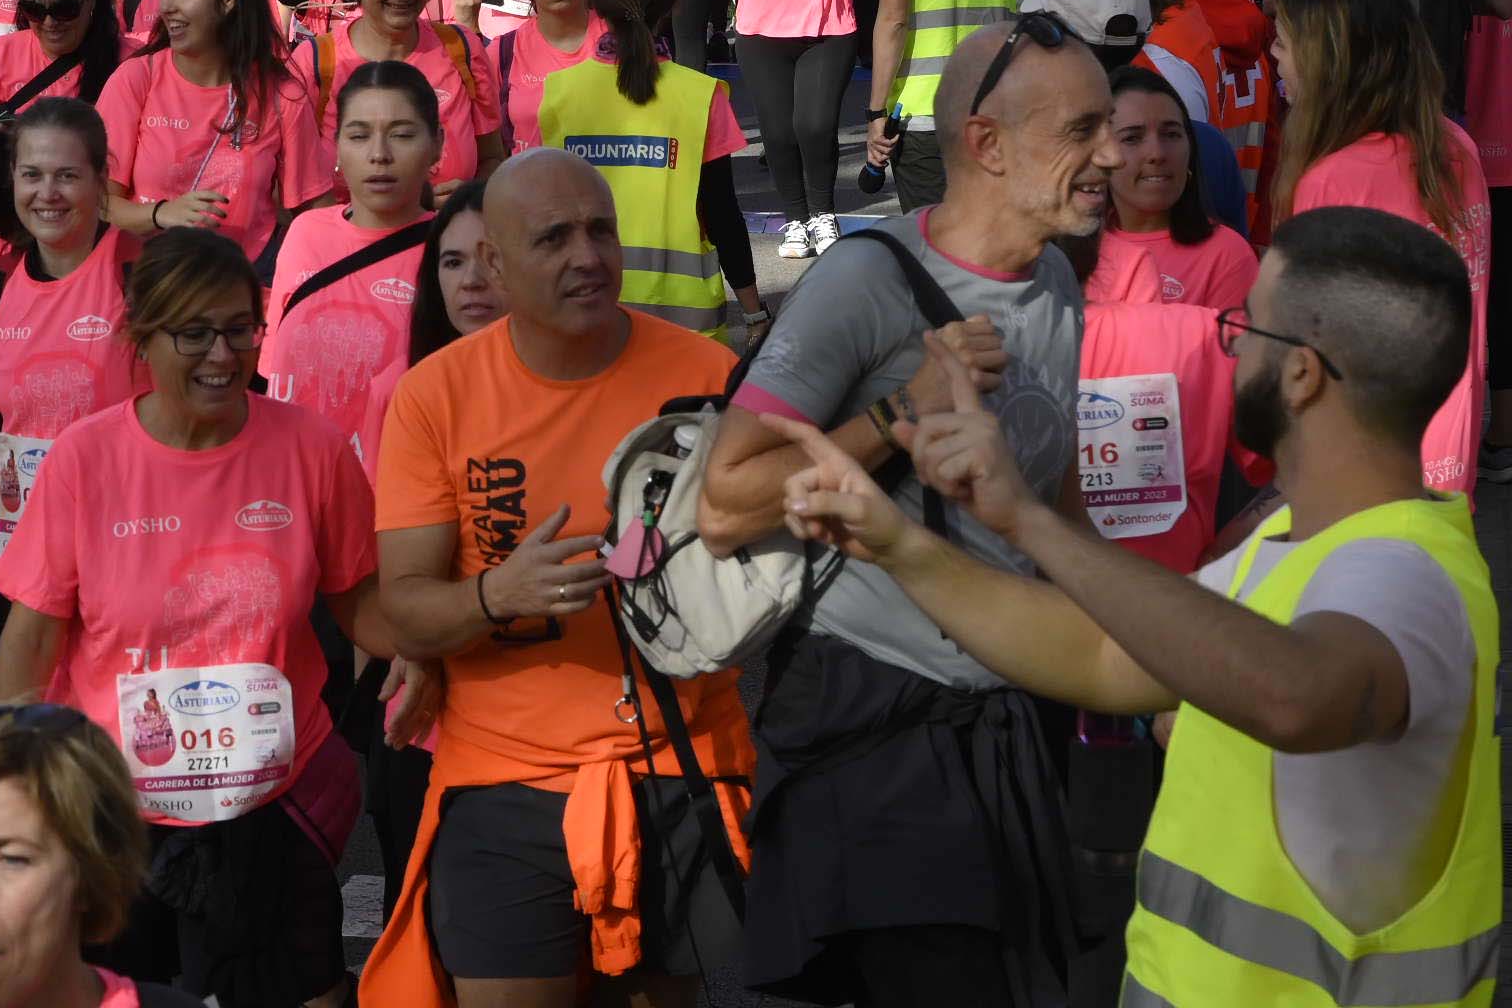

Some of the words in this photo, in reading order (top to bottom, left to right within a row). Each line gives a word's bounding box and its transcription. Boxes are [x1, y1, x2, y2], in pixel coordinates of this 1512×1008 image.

[147, 115, 190, 130] OYSHO
[566, 144, 665, 160] VOLUNTARIS
[1130, 398, 1165, 407] SUMA
[1081, 442, 1119, 464] 16
[1089, 495, 1102, 503] LA
[1107, 493, 1139, 502] MUJER
[1144, 491, 1166, 500] 2023
[239, 512, 289, 526] ASTURIANA
[1117, 512, 1173, 526] Santander
[113, 515, 181, 538] OYSHO
[247, 683, 278, 692] SUMA
[175, 694, 235, 708] ASTURIANA
[181, 727, 235, 750] 016
[188, 756, 229, 771] 27271
[145, 779, 190, 789] CARRERA
[193, 778, 205, 787] DE
[208, 777, 220, 786] LA
[222, 775, 254, 784] MUJER
